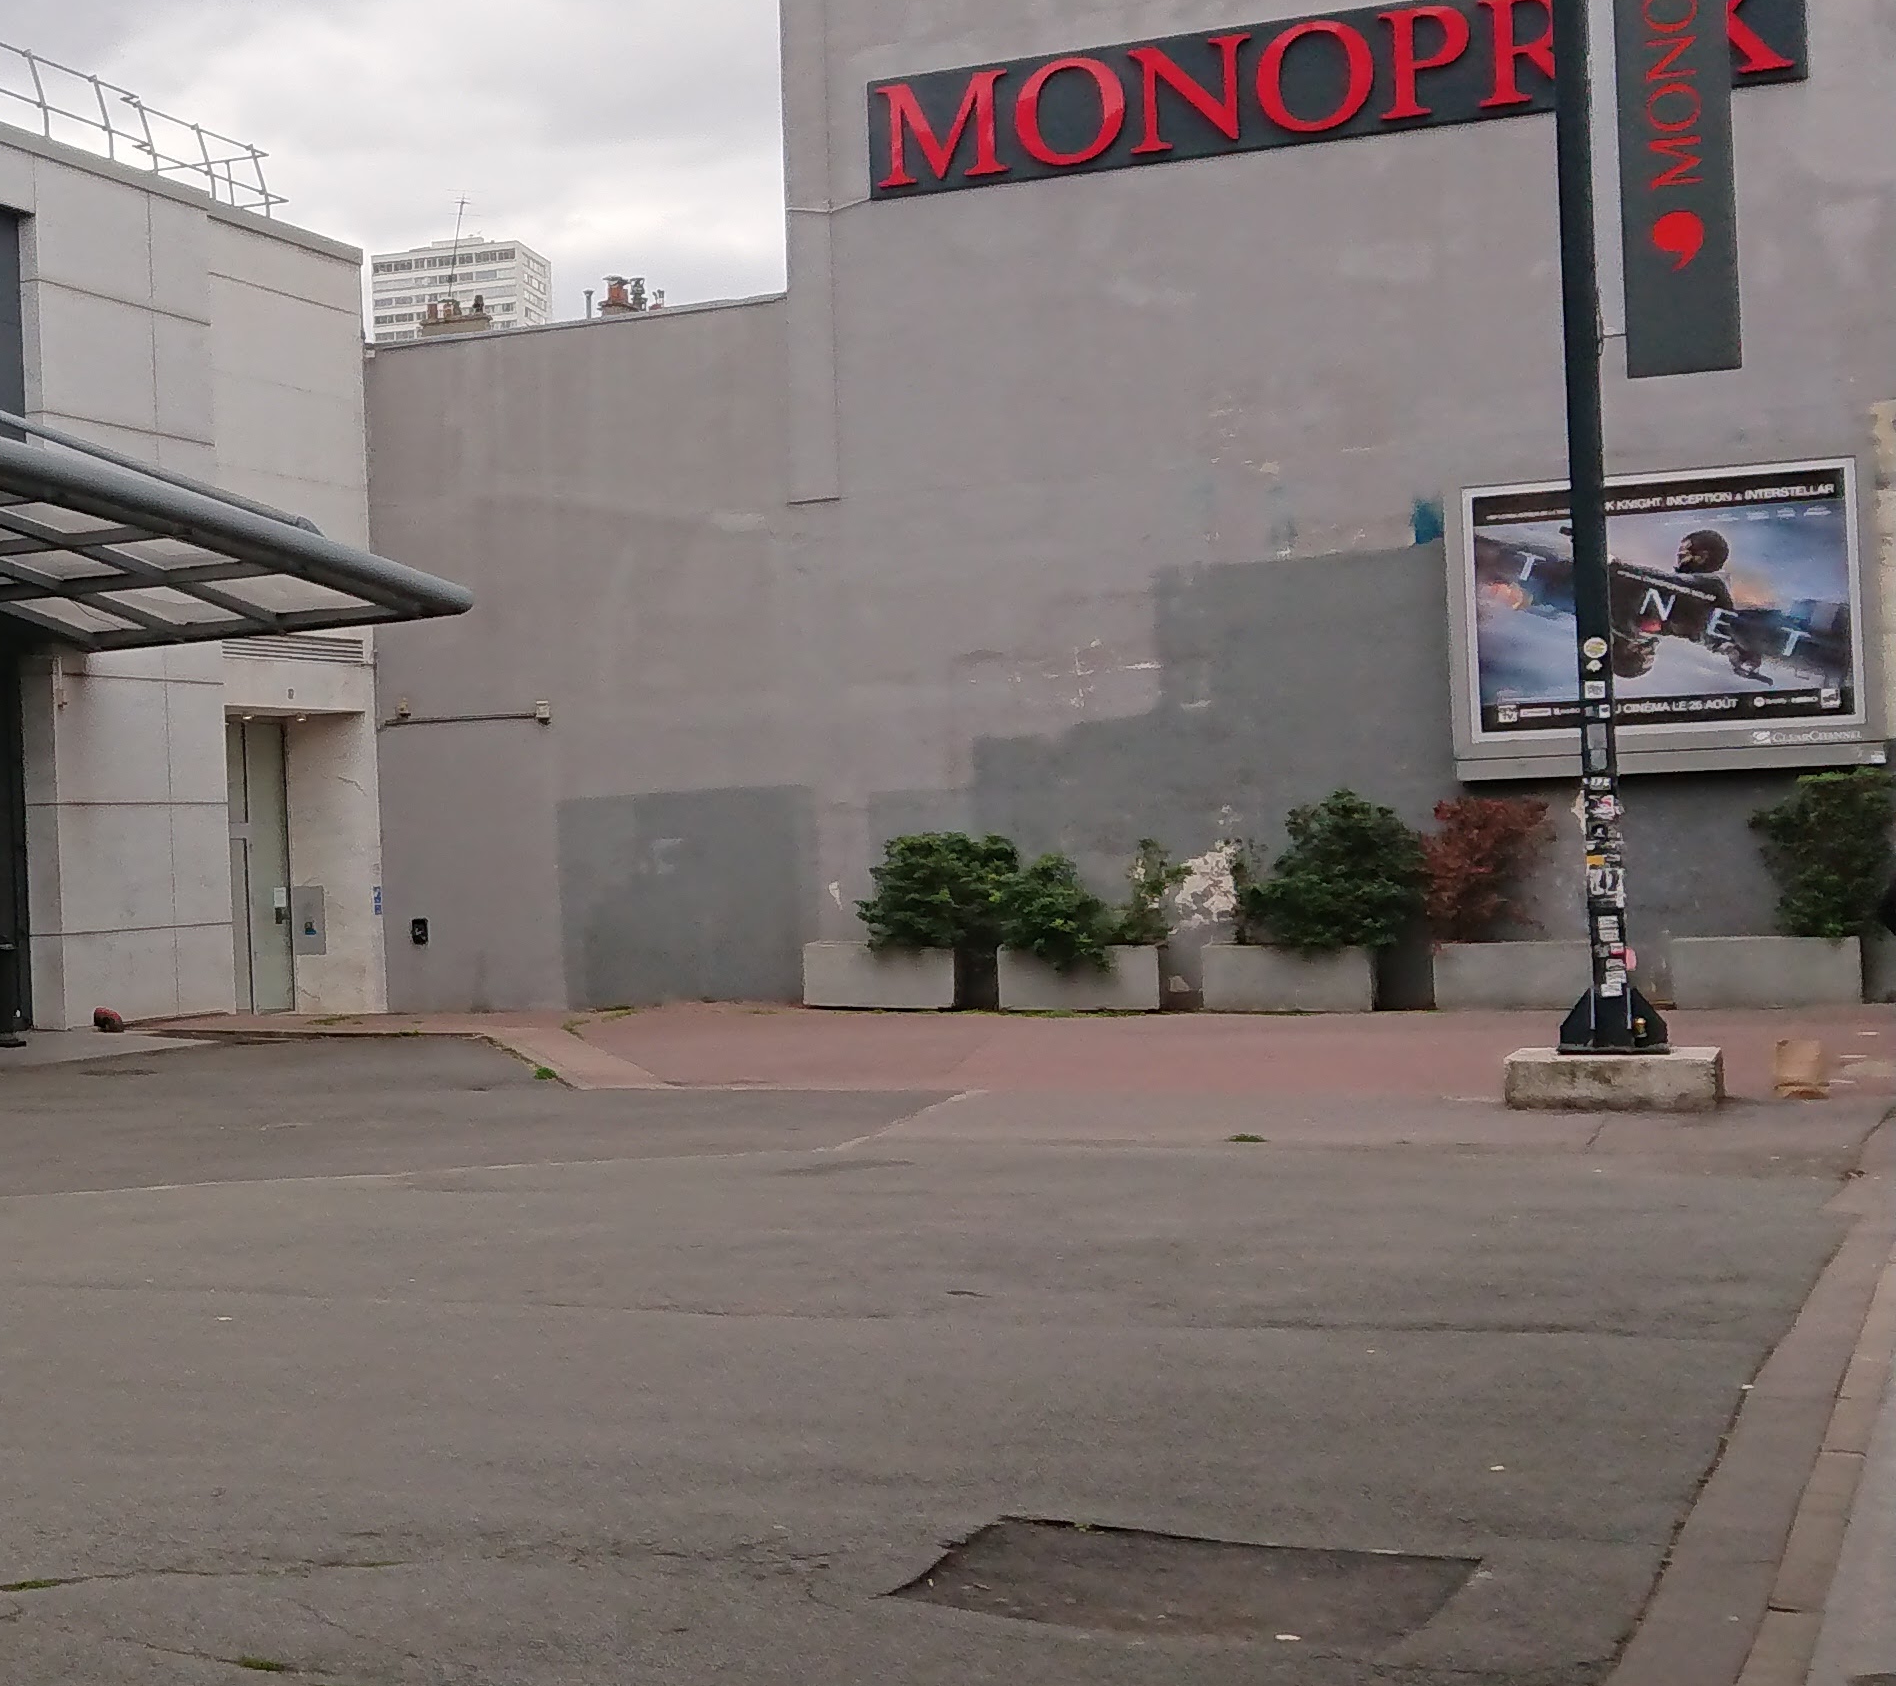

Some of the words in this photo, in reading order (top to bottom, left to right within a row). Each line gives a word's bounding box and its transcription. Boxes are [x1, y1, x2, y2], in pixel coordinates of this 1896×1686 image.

[1666, 491, 1732, 506] INCEPTION
[1745, 483, 1834, 501] INTERSTELLAR
[1672, 701, 1687, 711] LE
[1689, 700, 1702, 710] 26
